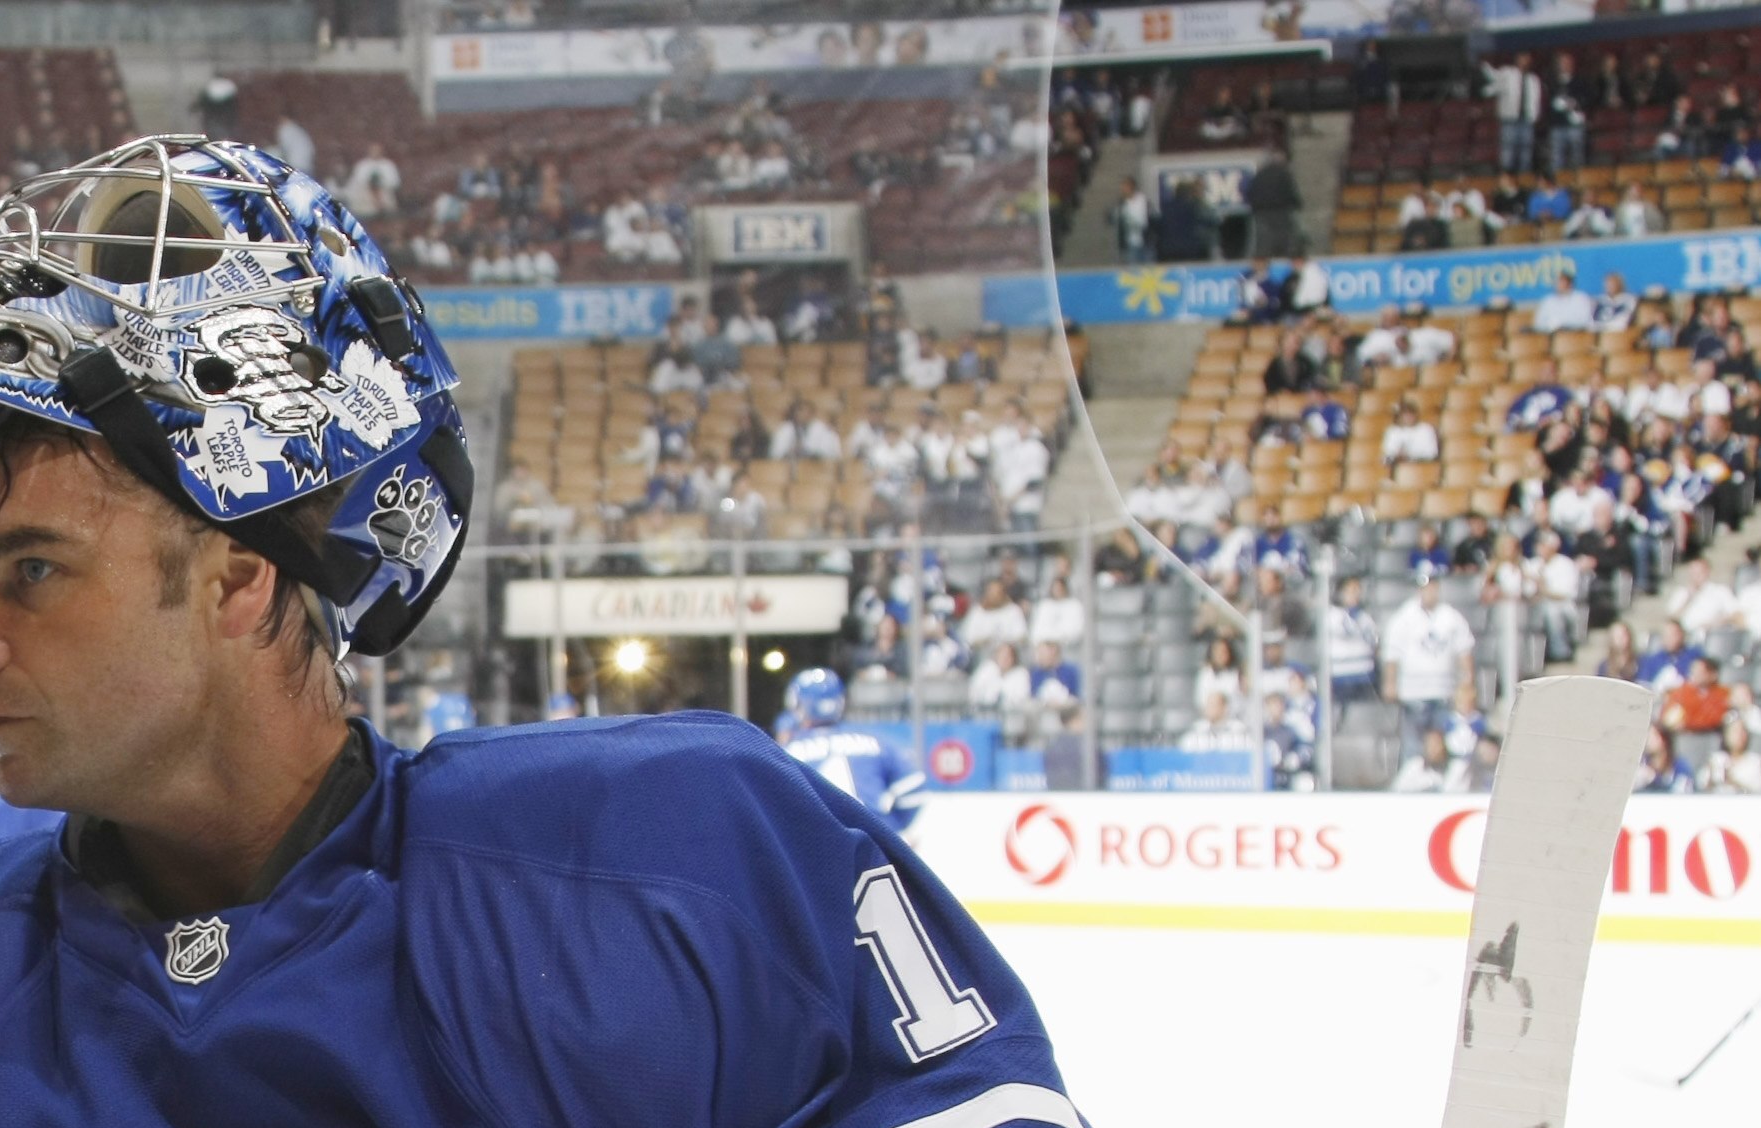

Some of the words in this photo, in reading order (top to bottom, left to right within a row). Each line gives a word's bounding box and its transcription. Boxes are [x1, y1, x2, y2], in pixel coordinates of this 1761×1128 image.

[741, 216, 816, 250] IBM
[1392, 263, 1439, 300] for
[124, 308, 186, 344] ORONTO
[559, 288, 656, 334] IBM
[118, 343, 156, 369] LEAFS
[120, 325, 165, 356] MAPLE
[340, 394, 377, 432] LEAFS
[350, 387, 385, 424] MAPLE
[355, 373, 399, 422] TORONTO
[206, 437, 229, 474] LEAFS
[215, 431, 240, 472] MAPLE
[223, 418, 253, 478] TORONTO
[593, 588, 738, 620] CANADIAN
[1098, 823, 1343, 870] ROGERS
[180, 934, 218, 972] NHL
[853, 864, 998, 1063] 1
